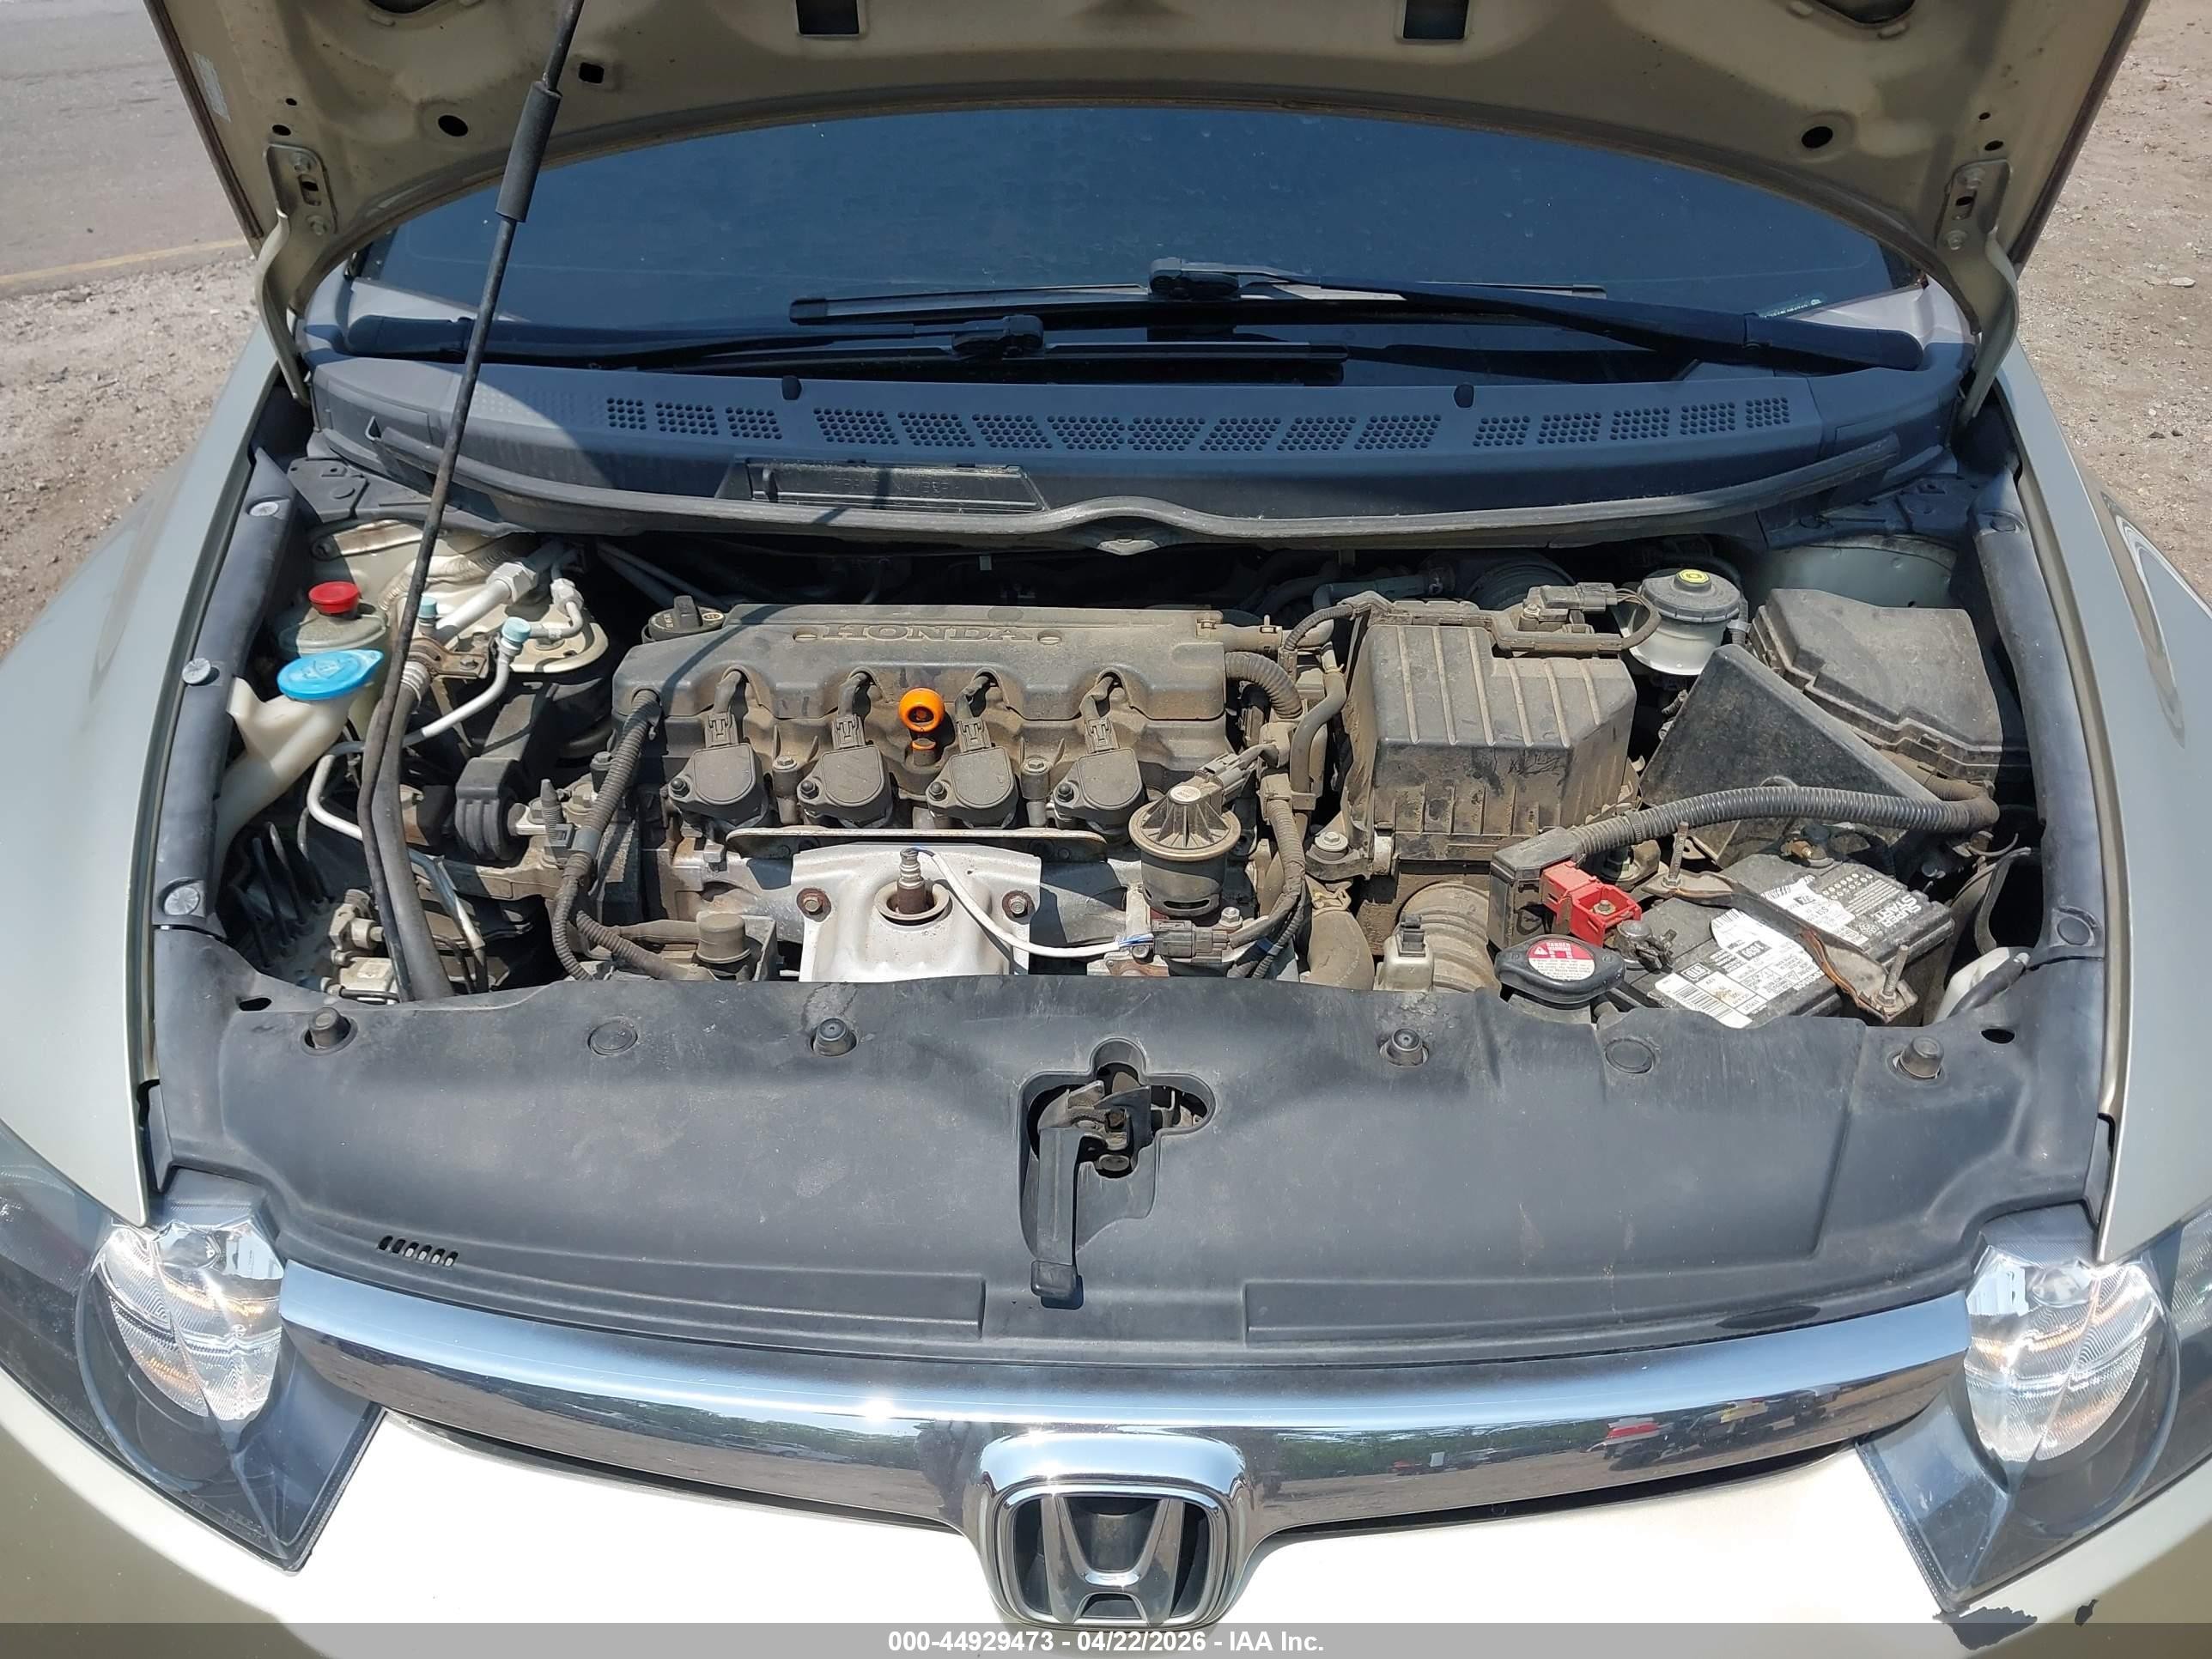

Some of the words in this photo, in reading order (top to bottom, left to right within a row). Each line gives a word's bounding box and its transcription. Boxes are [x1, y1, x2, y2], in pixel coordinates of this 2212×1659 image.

[822, 623, 1033, 641] HONDA
[1874, 894, 1917, 924] START
[1878, 903, 1922, 927] SUPER
